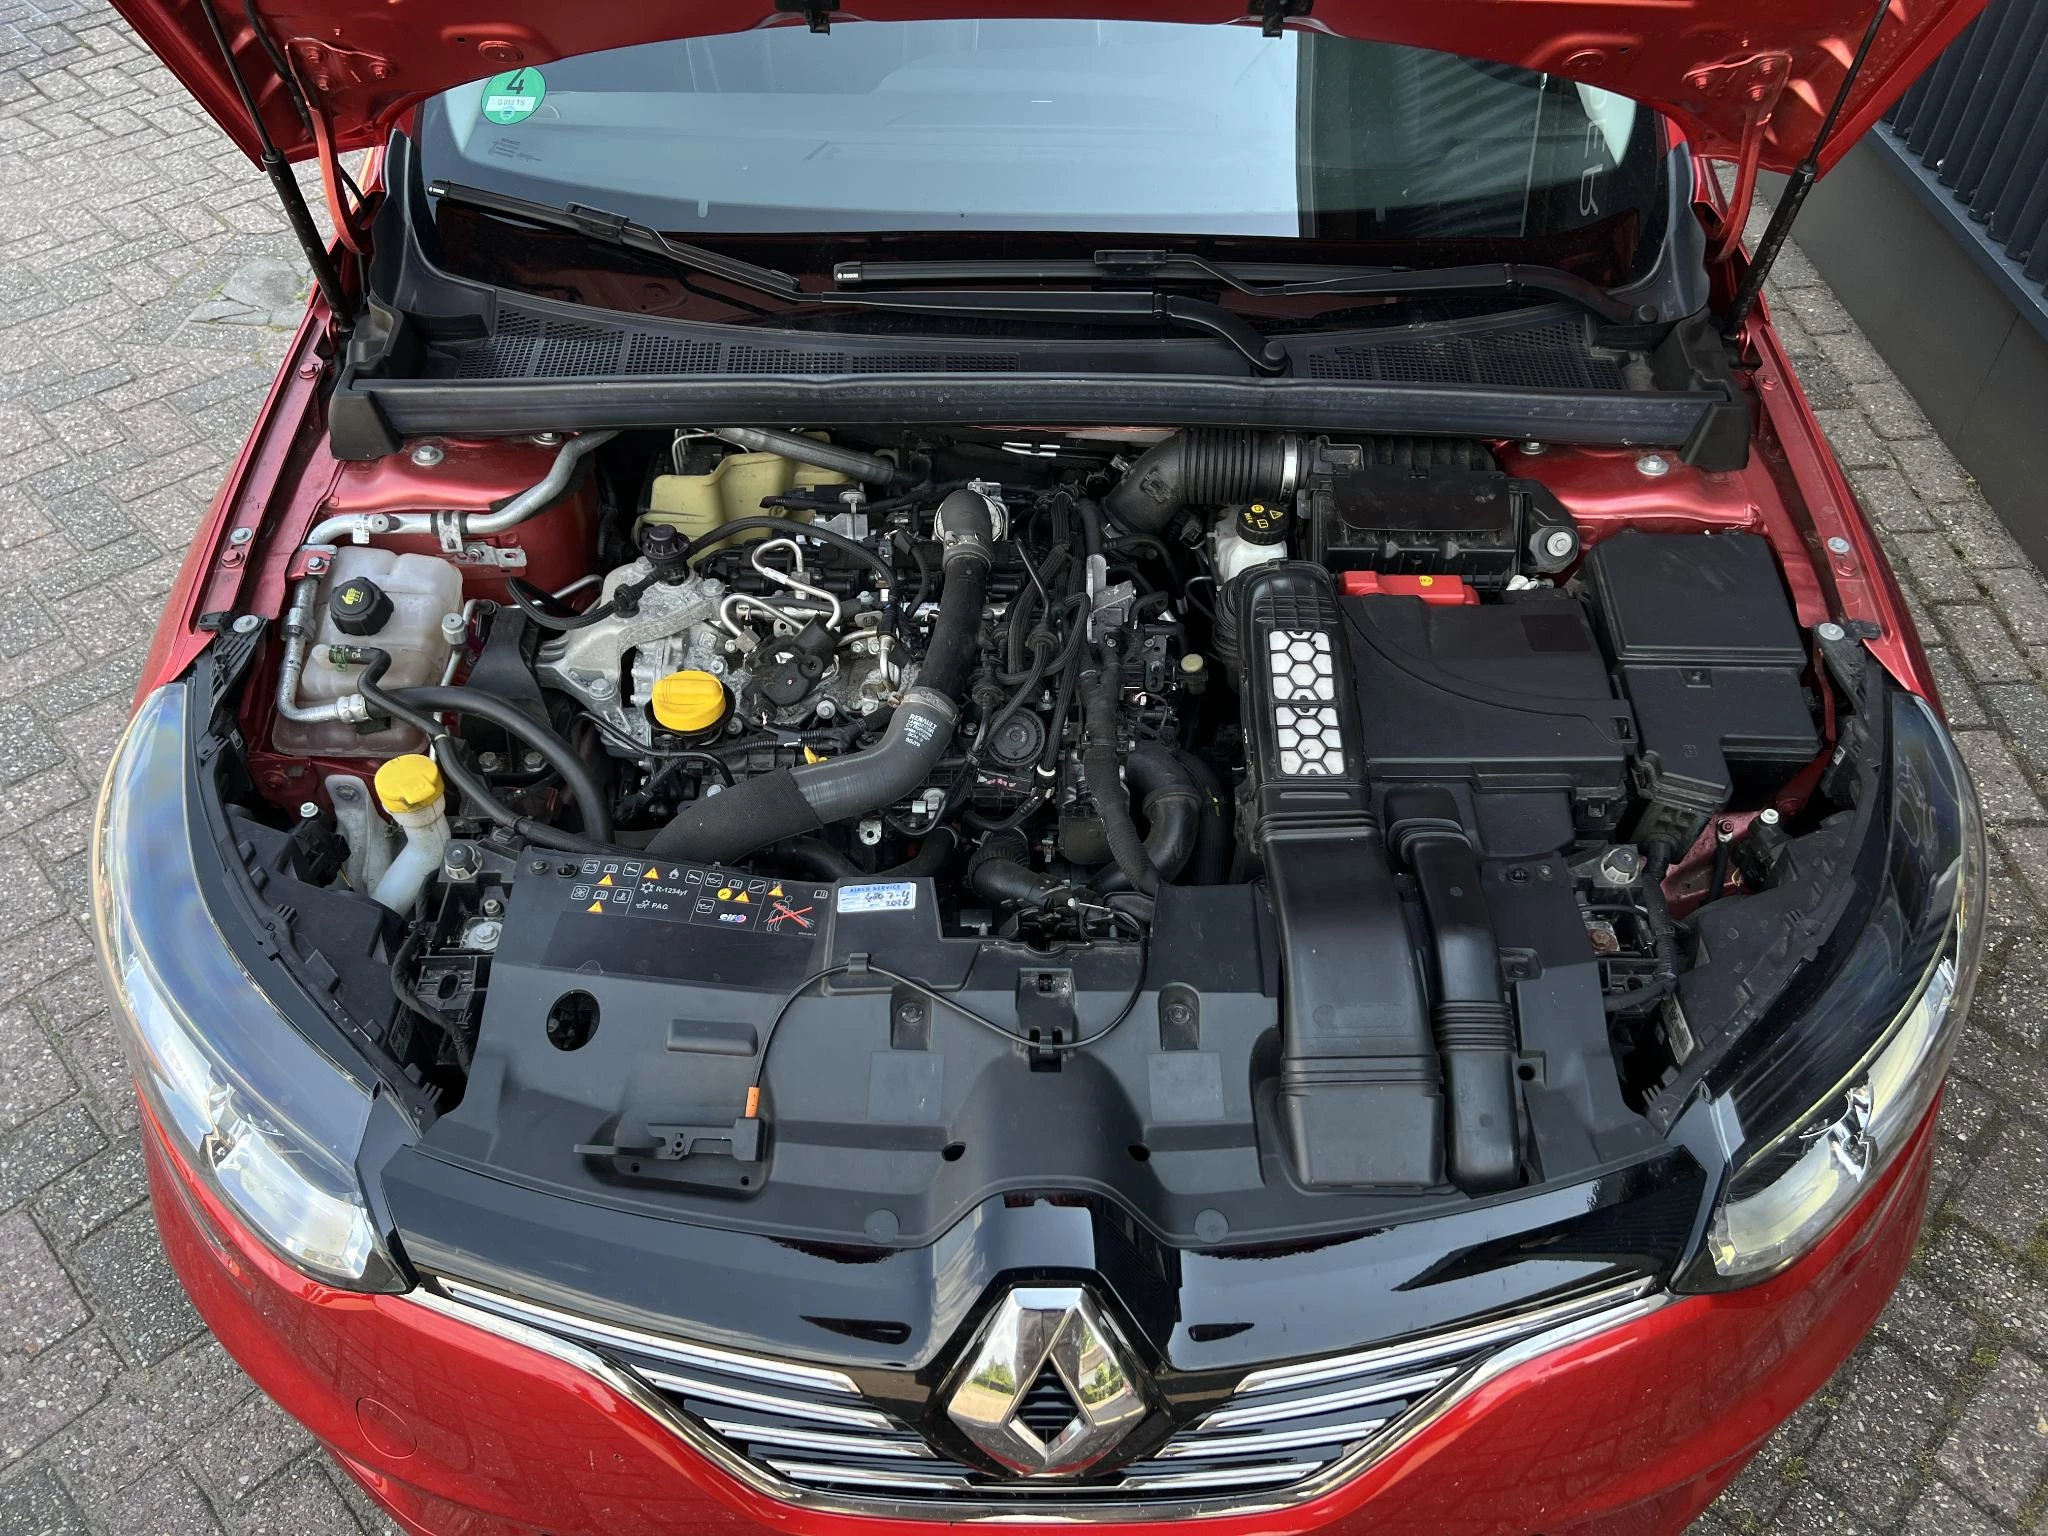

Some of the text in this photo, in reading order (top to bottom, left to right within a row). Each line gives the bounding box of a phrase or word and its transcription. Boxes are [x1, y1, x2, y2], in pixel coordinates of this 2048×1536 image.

[506, 68, 526, 94] 4
[909, 713, 938, 729] RENAULT
[655, 886, 688, 897] R-1234yf
[651, 902, 669, 910] PAG
